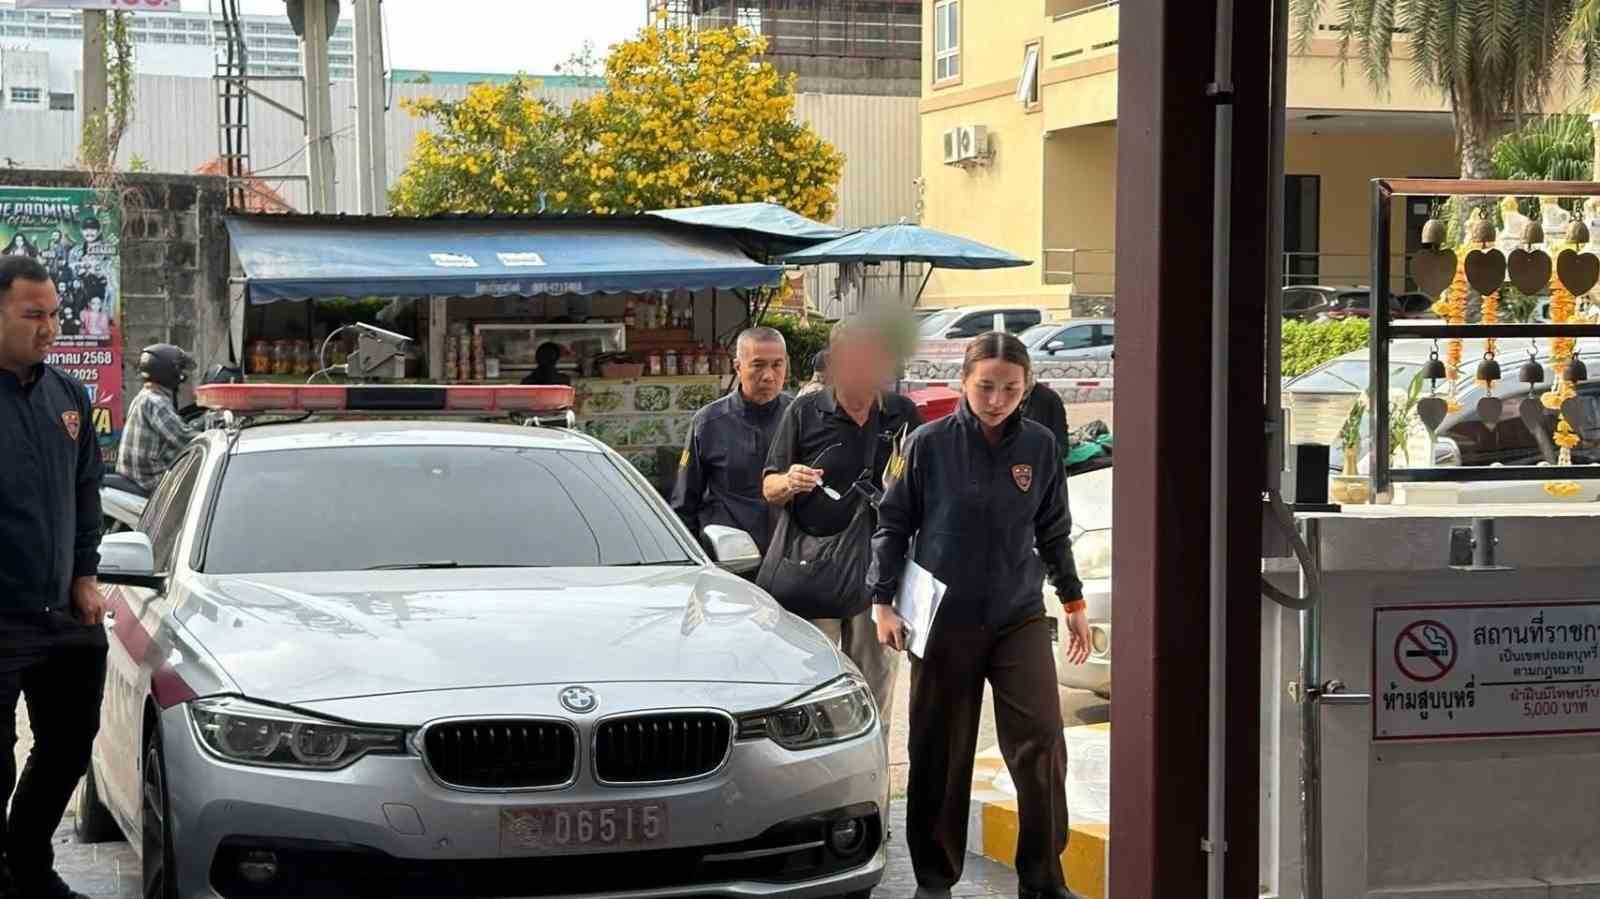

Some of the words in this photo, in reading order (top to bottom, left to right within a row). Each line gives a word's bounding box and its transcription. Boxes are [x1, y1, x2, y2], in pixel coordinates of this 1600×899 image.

[14, 202, 80, 218] PROMISE
[82, 351, 112, 364] 2568
[1472, 609, 1600, 646] สถานที่ราชก
[1383, 673, 1475, 720] ห้ามสูบบุหรี่
[1522, 701, 1559, 718] 5,000
[1562, 700, 1589, 714] บาท
[555, 805, 660, 843] 06515
